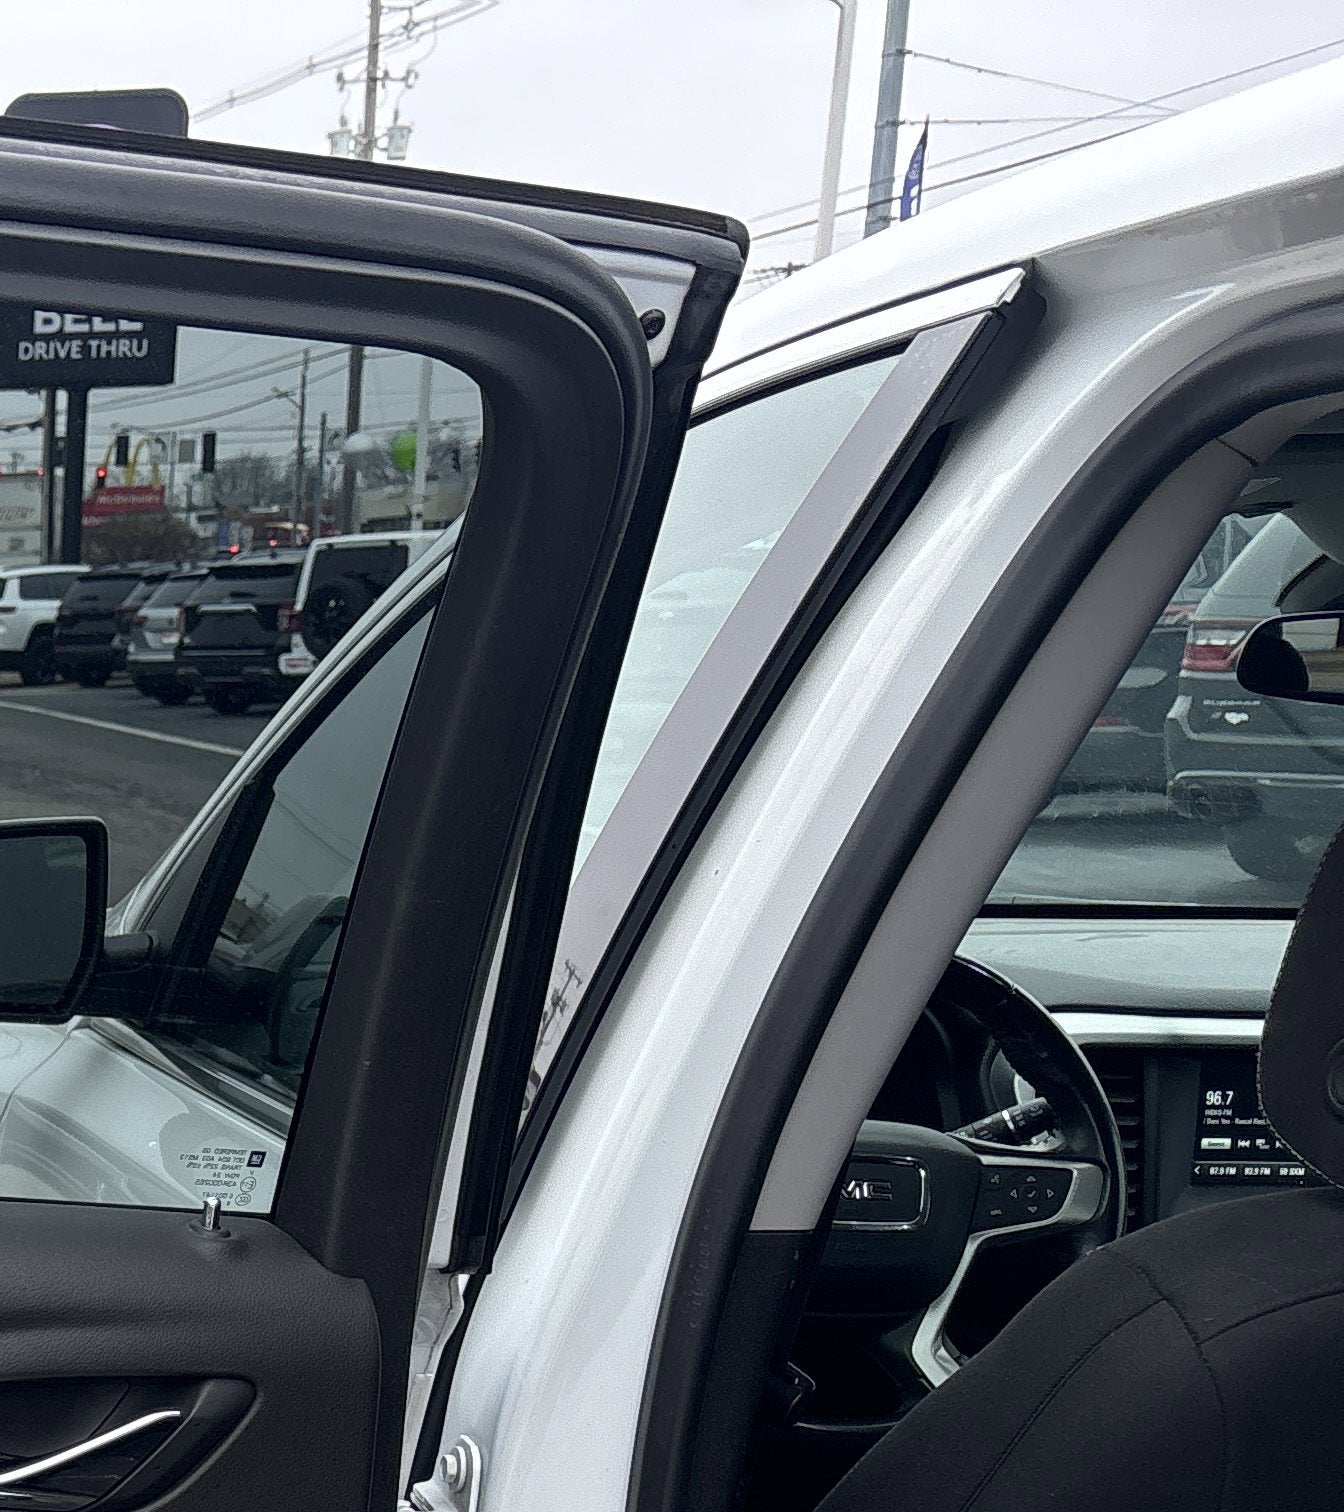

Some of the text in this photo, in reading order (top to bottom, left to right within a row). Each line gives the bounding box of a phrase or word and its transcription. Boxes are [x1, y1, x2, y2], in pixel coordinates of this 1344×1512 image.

[18, 337, 149, 361] DRIVE THRU
[1205, 1090, 1234, 1106] 96.7
[841, 1180, 893, 1200] MC
